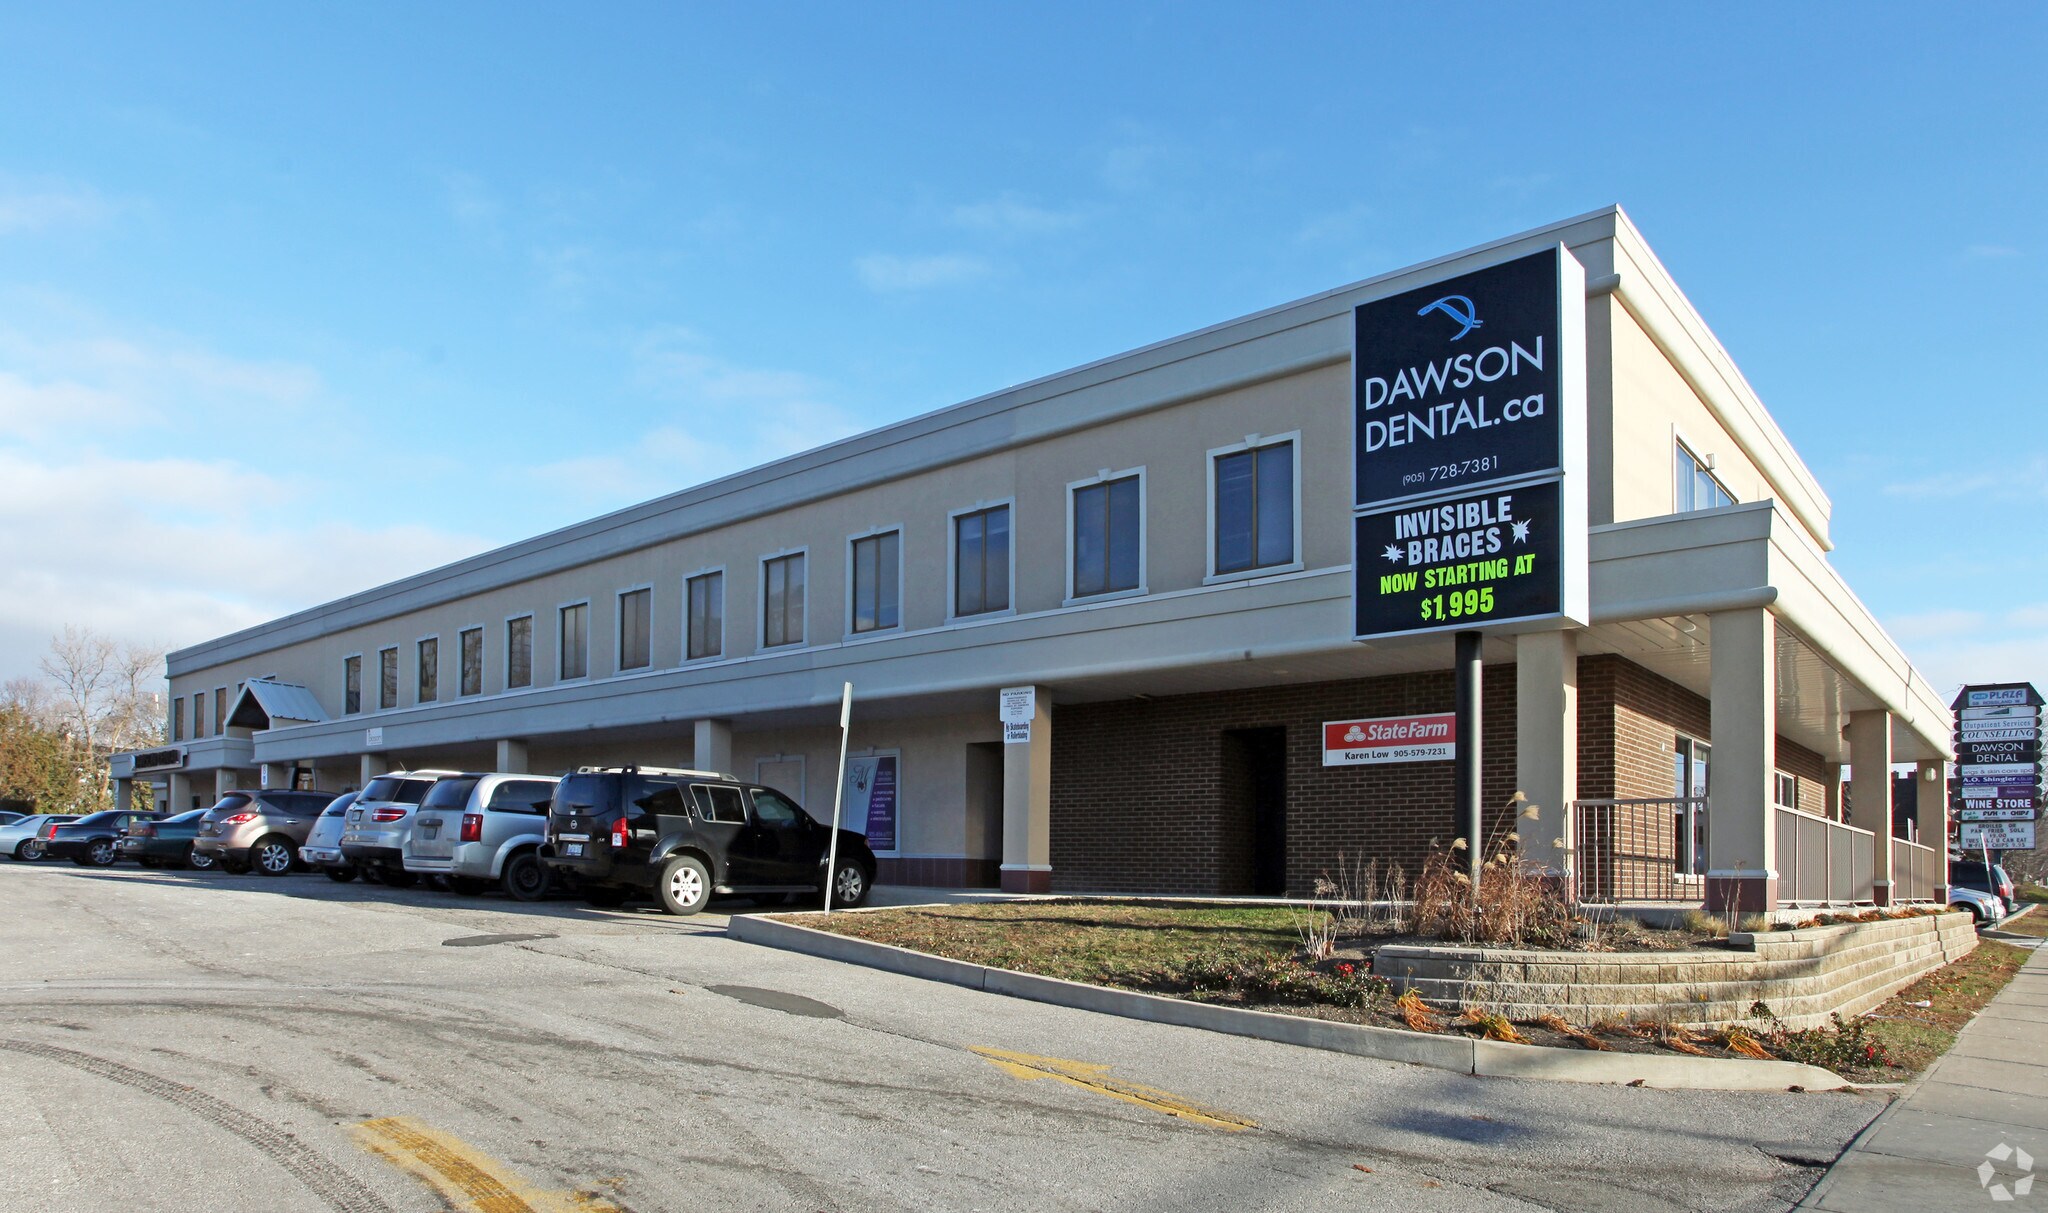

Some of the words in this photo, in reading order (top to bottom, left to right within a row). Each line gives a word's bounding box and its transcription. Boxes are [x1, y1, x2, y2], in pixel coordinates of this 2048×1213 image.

[1366, 335, 1543, 411] DAWSON
[1366, 393, 1544, 453] DENTAL.ca
[1402, 472, 1425, 486] (905)
[1430, 456, 1498, 481] 728-7381
[1395, 495, 1512, 540] INVISIBLE
[1408, 526, 1501, 566] BRACES
[1380, 572, 1418, 594] NOW
[1424, 558, 1508, 589] STARTING
[1514, 553, 1536, 576] AT
[1421, 586, 1495, 621] $1,995
[1989, 690, 2023, 699] PLAZA
[1961, 729, 2033, 739] COUNSELLING
[1964, 721, 2000, 729] Outpatient
[1345, 751, 1369, 760] Karen
[1372, 750, 1389, 759] Low
[1393, 748, 1447, 758] 905-579-7231
[1971, 742, 2024, 753] DAWSON
[1976, 753, 2018, 763] DENTAL
[1996, 798, 2032, 808] STORE
